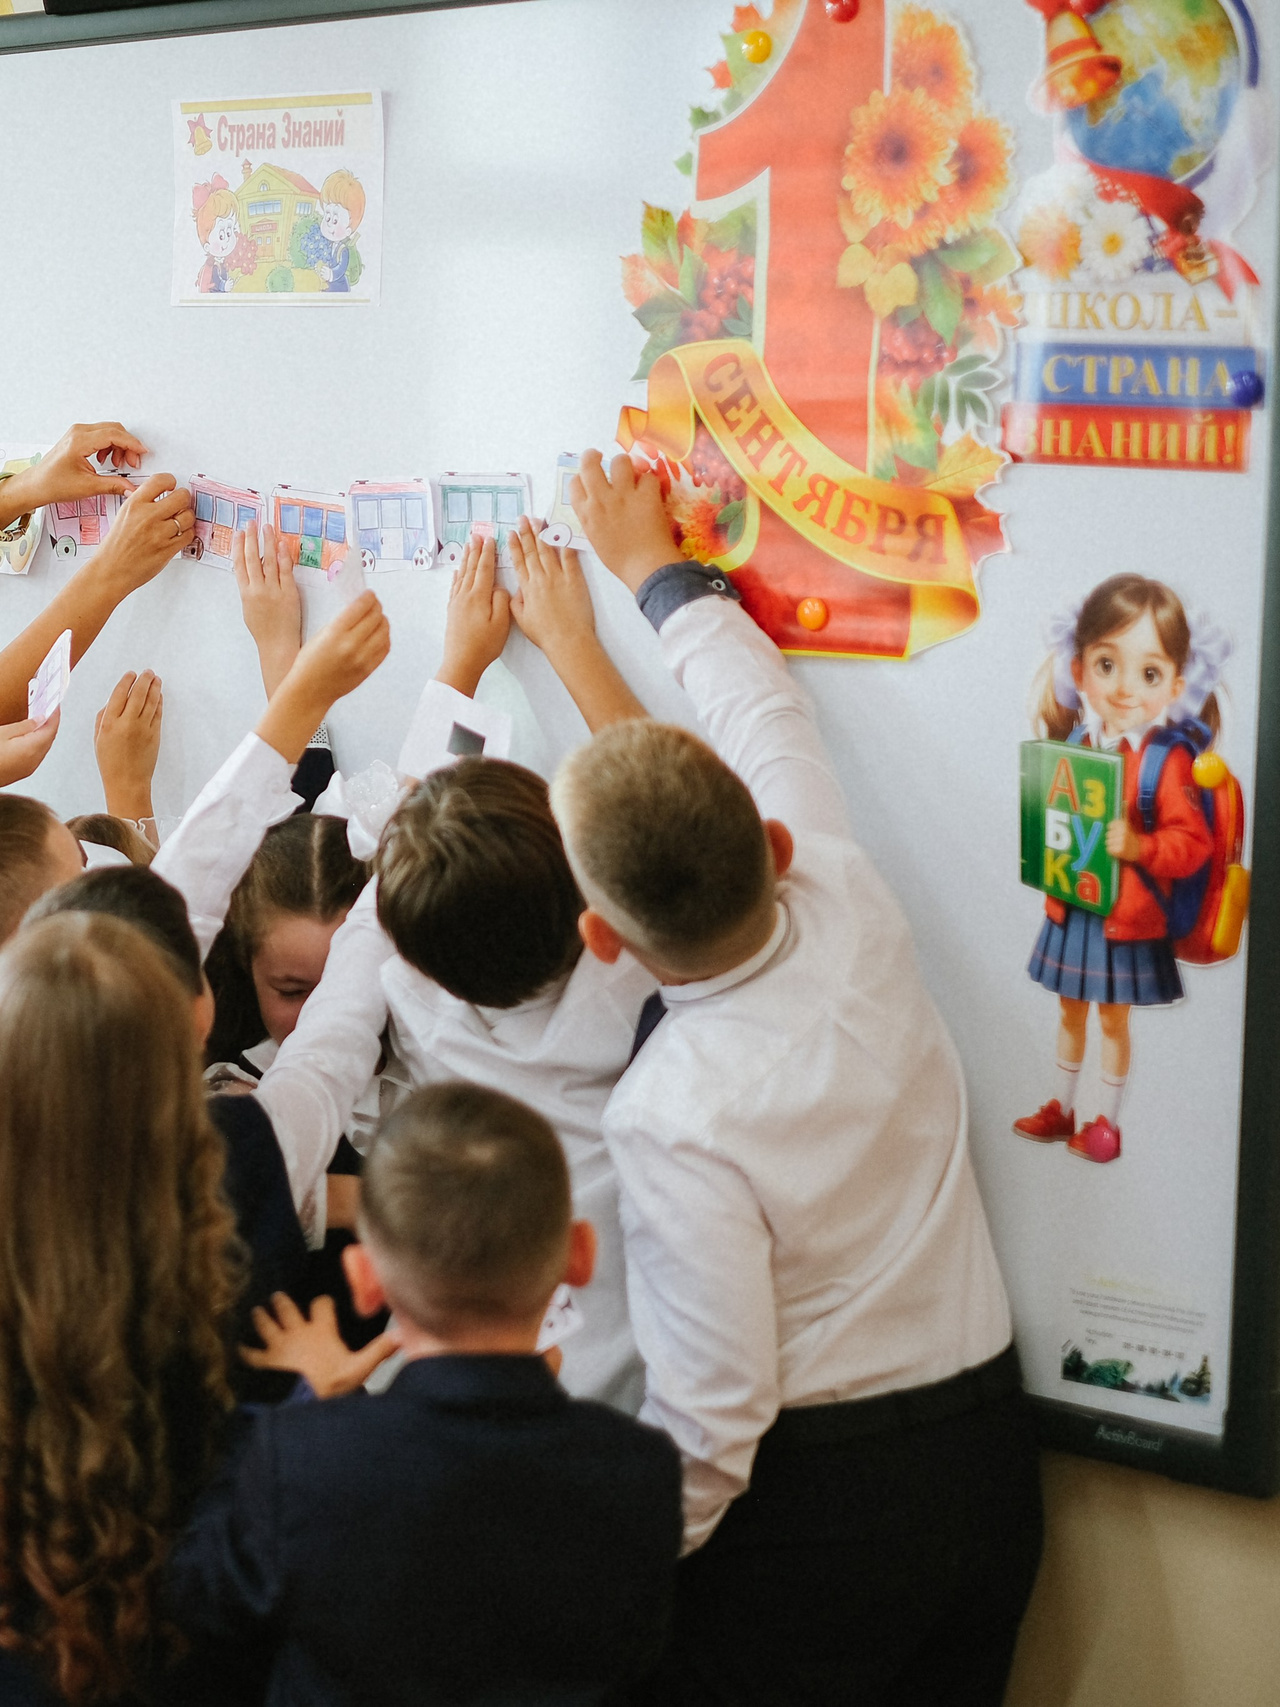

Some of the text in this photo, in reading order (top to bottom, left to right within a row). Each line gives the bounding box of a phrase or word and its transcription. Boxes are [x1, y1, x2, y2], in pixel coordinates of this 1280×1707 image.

[217, 109, 346, 157] Страна Знаний
[1042, 354, 1233, 397] СТРАНА
[703, 352, 948, 565] СЕНТЯБРЯ
